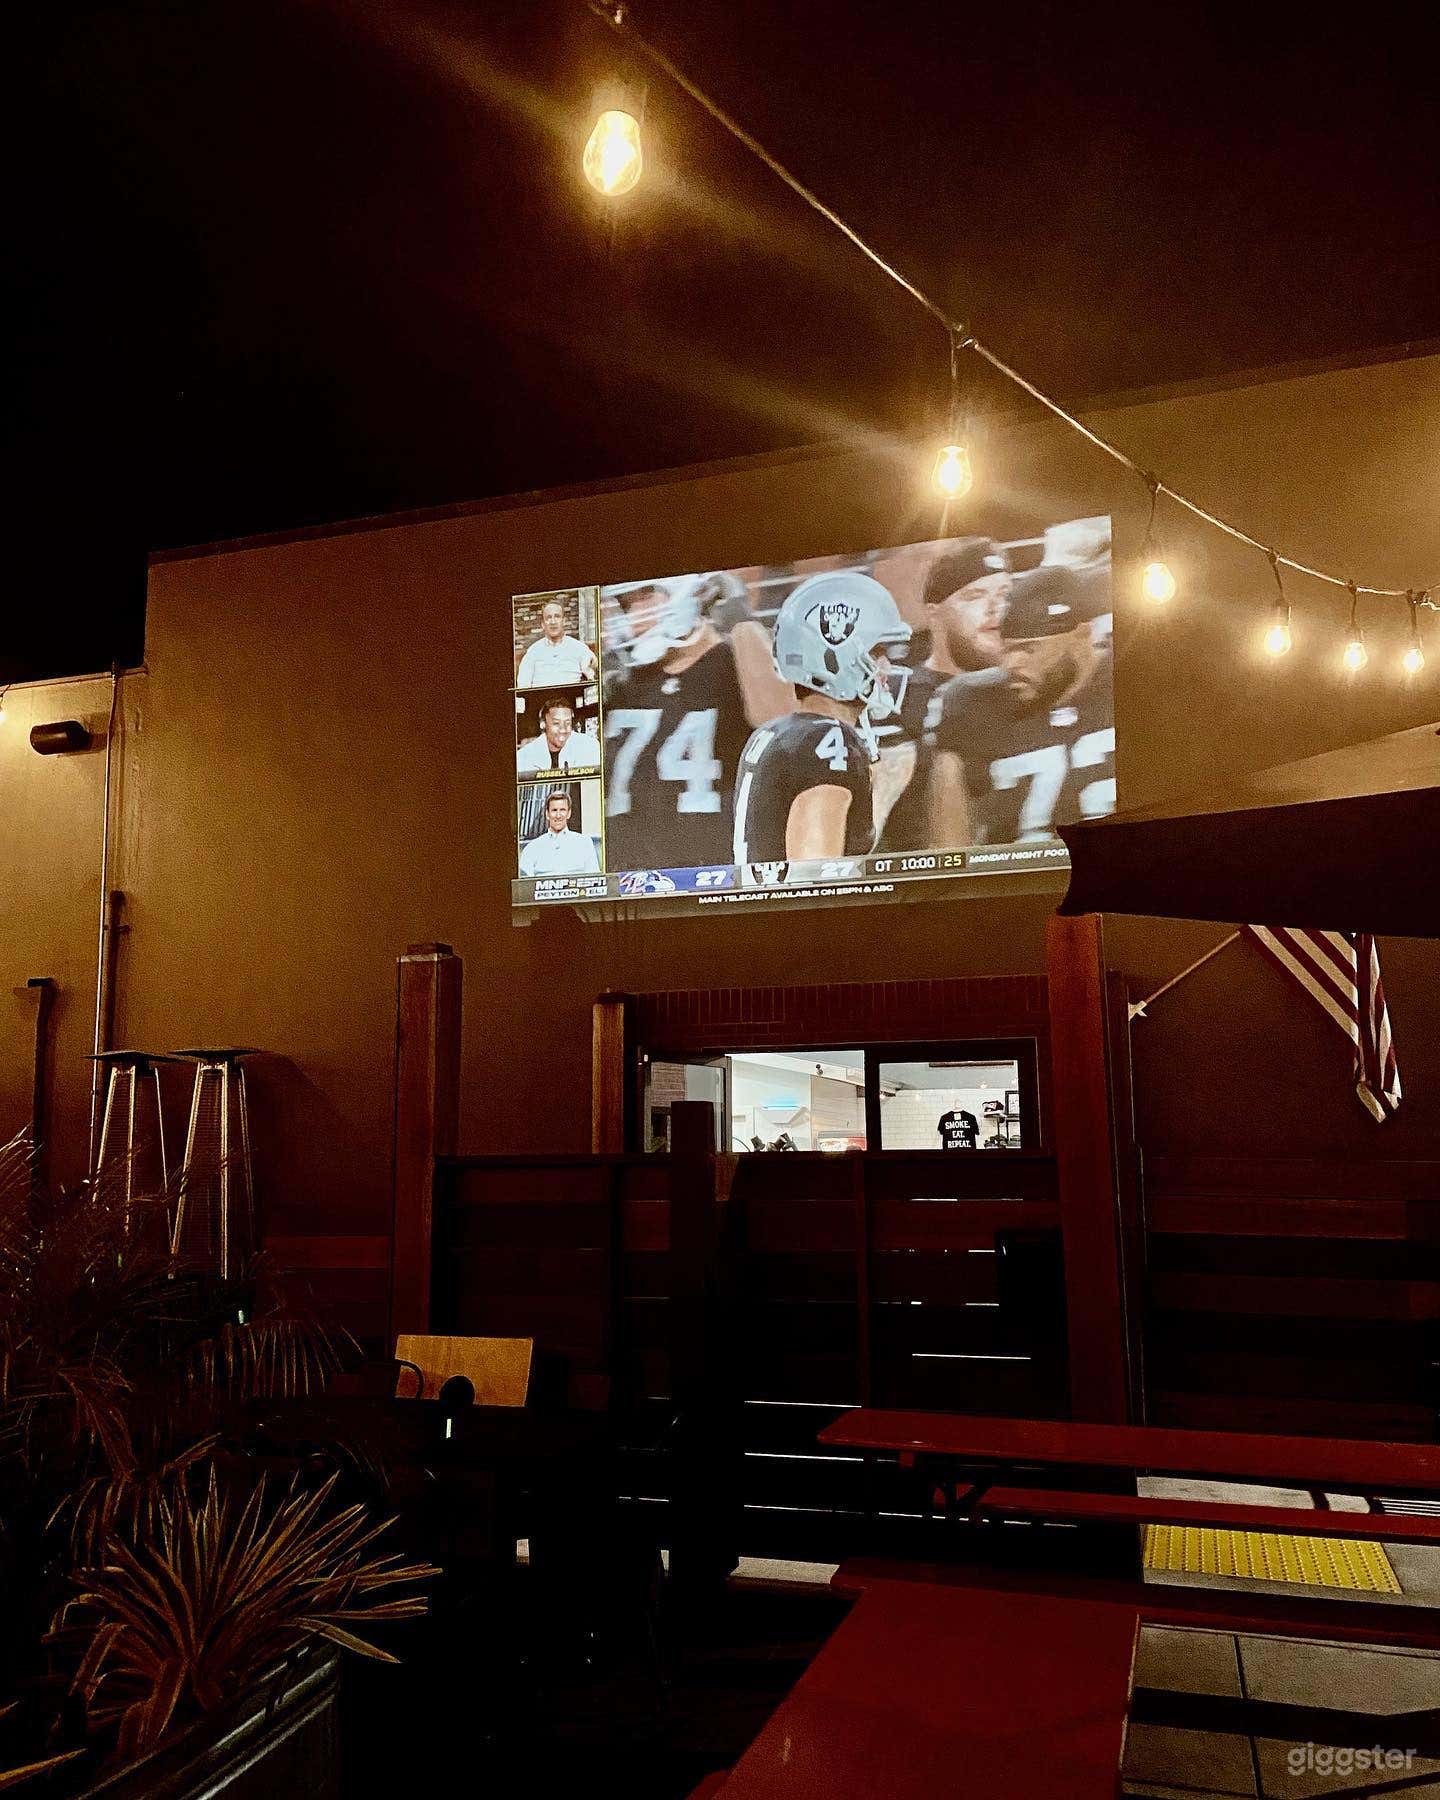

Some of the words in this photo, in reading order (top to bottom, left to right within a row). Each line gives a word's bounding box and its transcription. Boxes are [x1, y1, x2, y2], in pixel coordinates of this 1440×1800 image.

[875, 860, 892, 872] OT
[901, 856, 936, 870] 10:00
[943, 855, 962, 867] 25
[969, 852, 1009, 864] MONDAY
[1011, 850, 1042, 860] NIGHT
[820, 862, 855, 878] 27
[535, 879, 569, 891] MNF
[577, 877, 606, 887] ESPN
[695, 871, 727, 886] 27
[536, 890, 578, 898] PEYTON
[724, 892, 769, 902] TELECAST
[770, 889, 819, 899] AVAILABLE
[820, 888, 837, 896] ON
[838, 885, 863, 894] ESPN
[873, 884, 894, 892] ABC
[945, 1120, 970, 1130] SMOKE.
[952, 1130, 965, 1138] EAT.
[947, 1140, 971, 1149] REPEAT.
